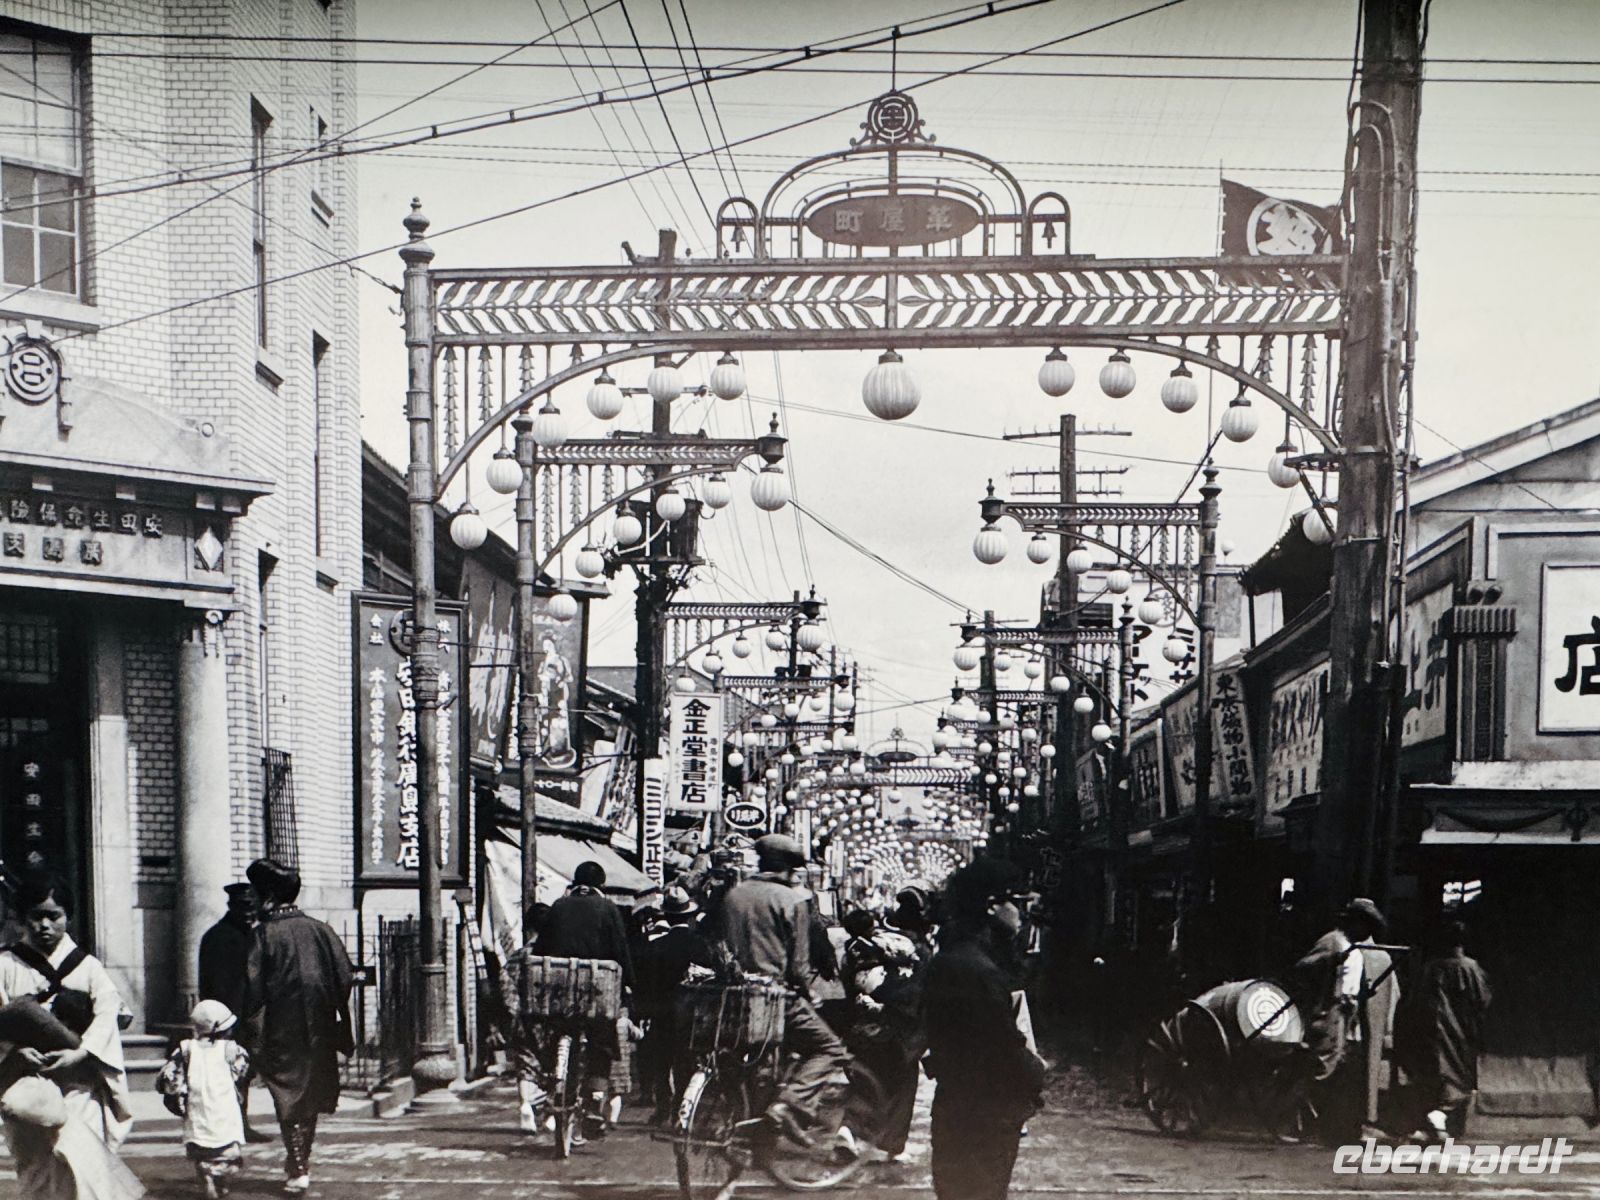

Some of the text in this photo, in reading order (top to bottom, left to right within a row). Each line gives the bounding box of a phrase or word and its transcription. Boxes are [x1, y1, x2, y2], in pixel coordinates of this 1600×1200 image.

[0, 499, 163, 538] 安田生命保險
[681, 698, 711, 803] 金正堂書店
